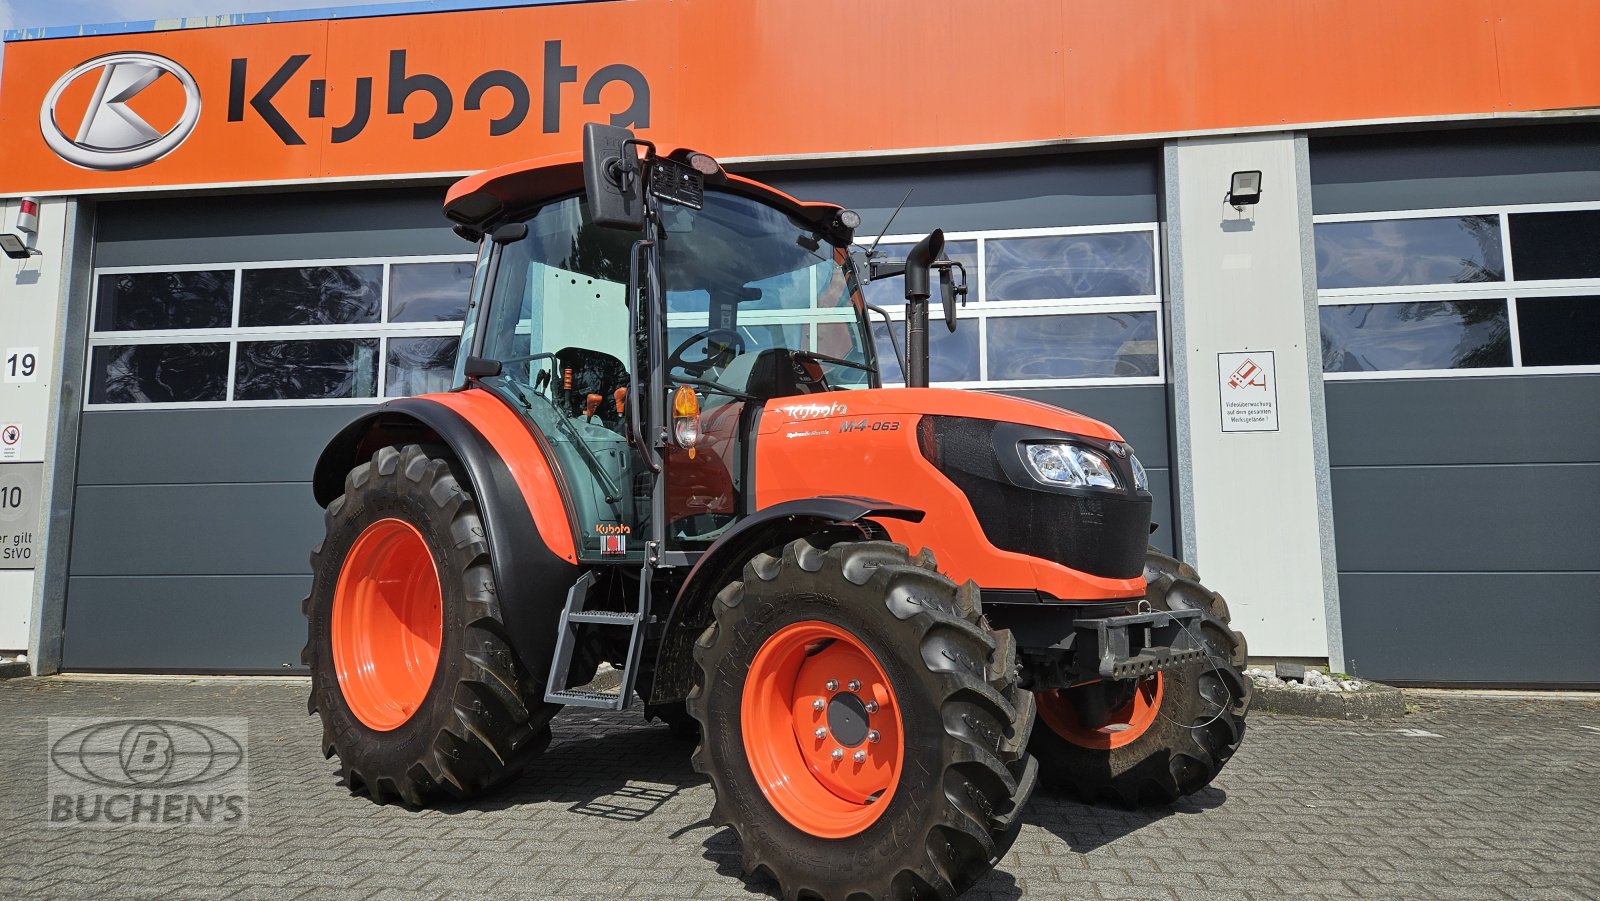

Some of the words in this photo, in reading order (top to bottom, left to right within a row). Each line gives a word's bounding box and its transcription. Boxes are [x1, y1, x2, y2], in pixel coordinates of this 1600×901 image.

[226, 40, 651, 146] Kubota
[7, 353, 36, 377] 19
[786, 400, 848, 420] Kubota
[839, 419, 900, 433] M4-063
[1, 486, 21, 508] 10
[595, 523, 631, 535] Kubota
[14, 531, 32, 547] gilt
[3, 547, 31, 559] StVO
